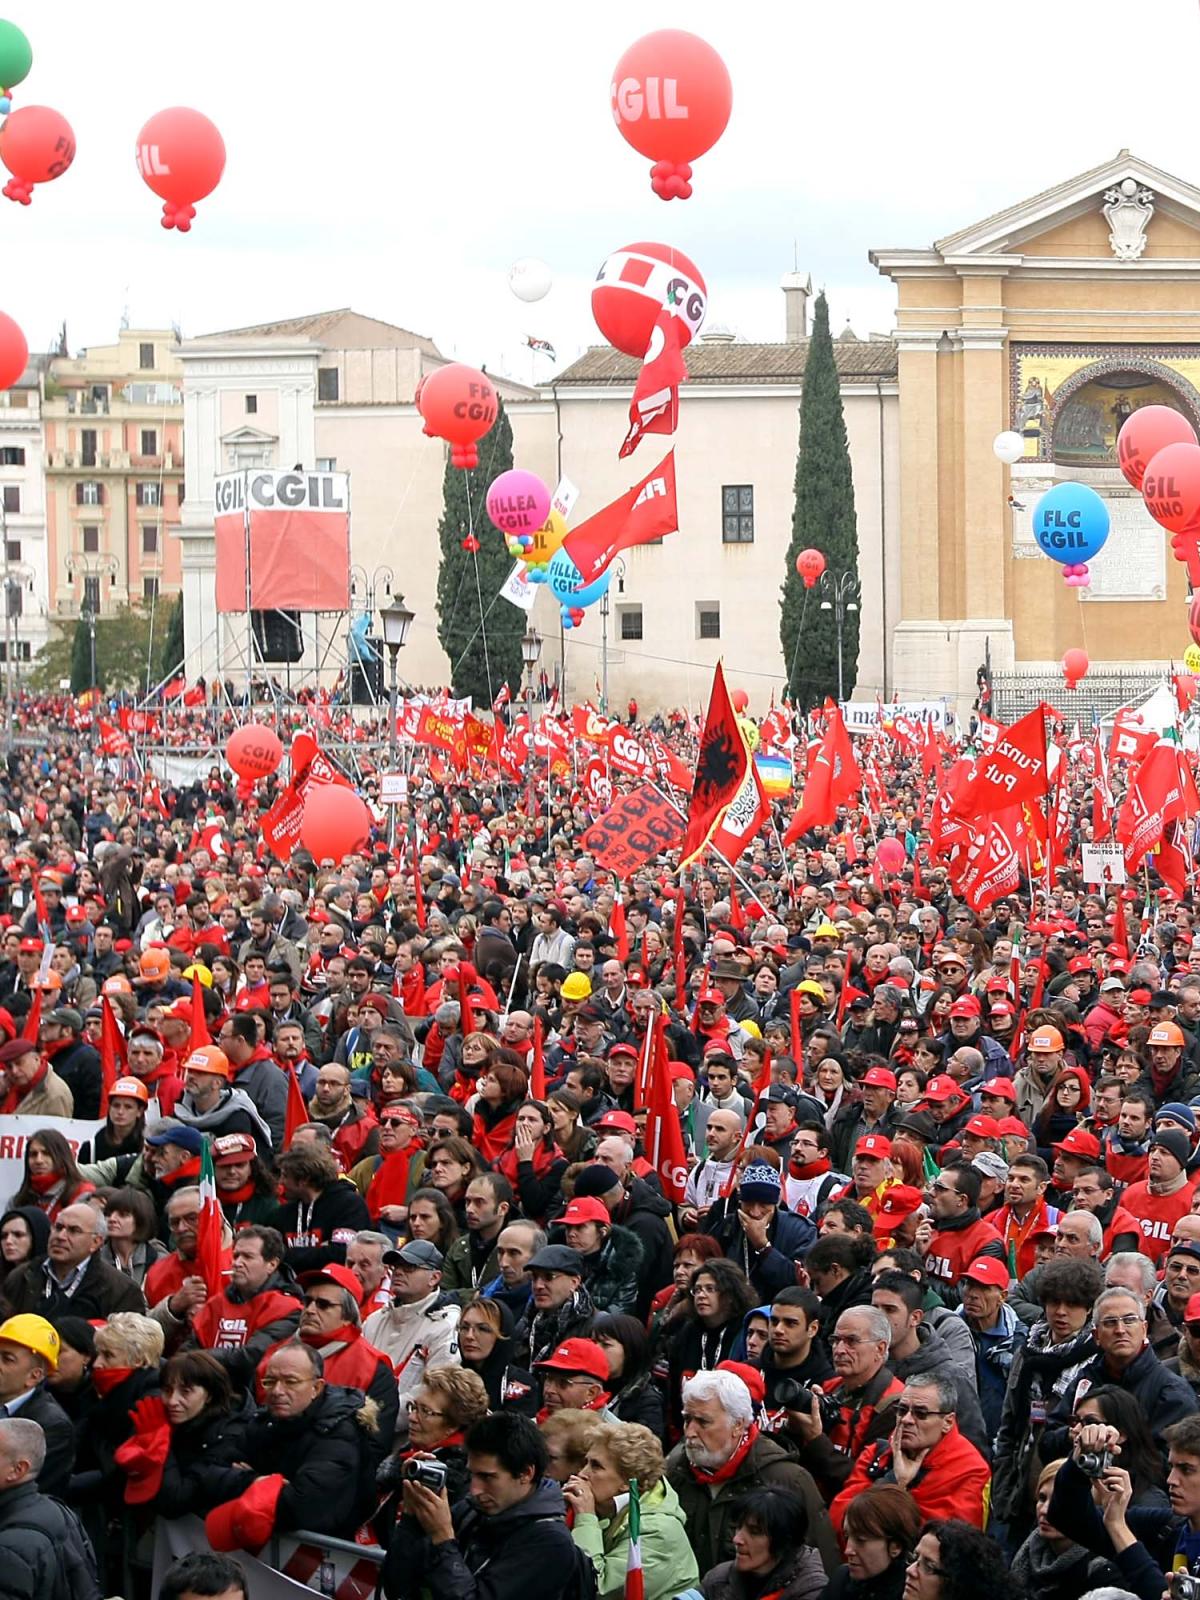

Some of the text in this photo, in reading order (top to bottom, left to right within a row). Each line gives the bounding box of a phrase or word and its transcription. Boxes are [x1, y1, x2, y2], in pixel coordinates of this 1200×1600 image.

[469, 382, 490, 399] FP
[453, 401, 495, 424] CGIL
[252, 475, 342, 507] CGIL
[490, 495, 537, 516] FILLEA
[497, 513, 531, 530] CGIL
[1044, 510, 1082, 528] FLC
[1040, 531, 1089, 549] CGIL
[241, 743, 276, 763] CGIL
